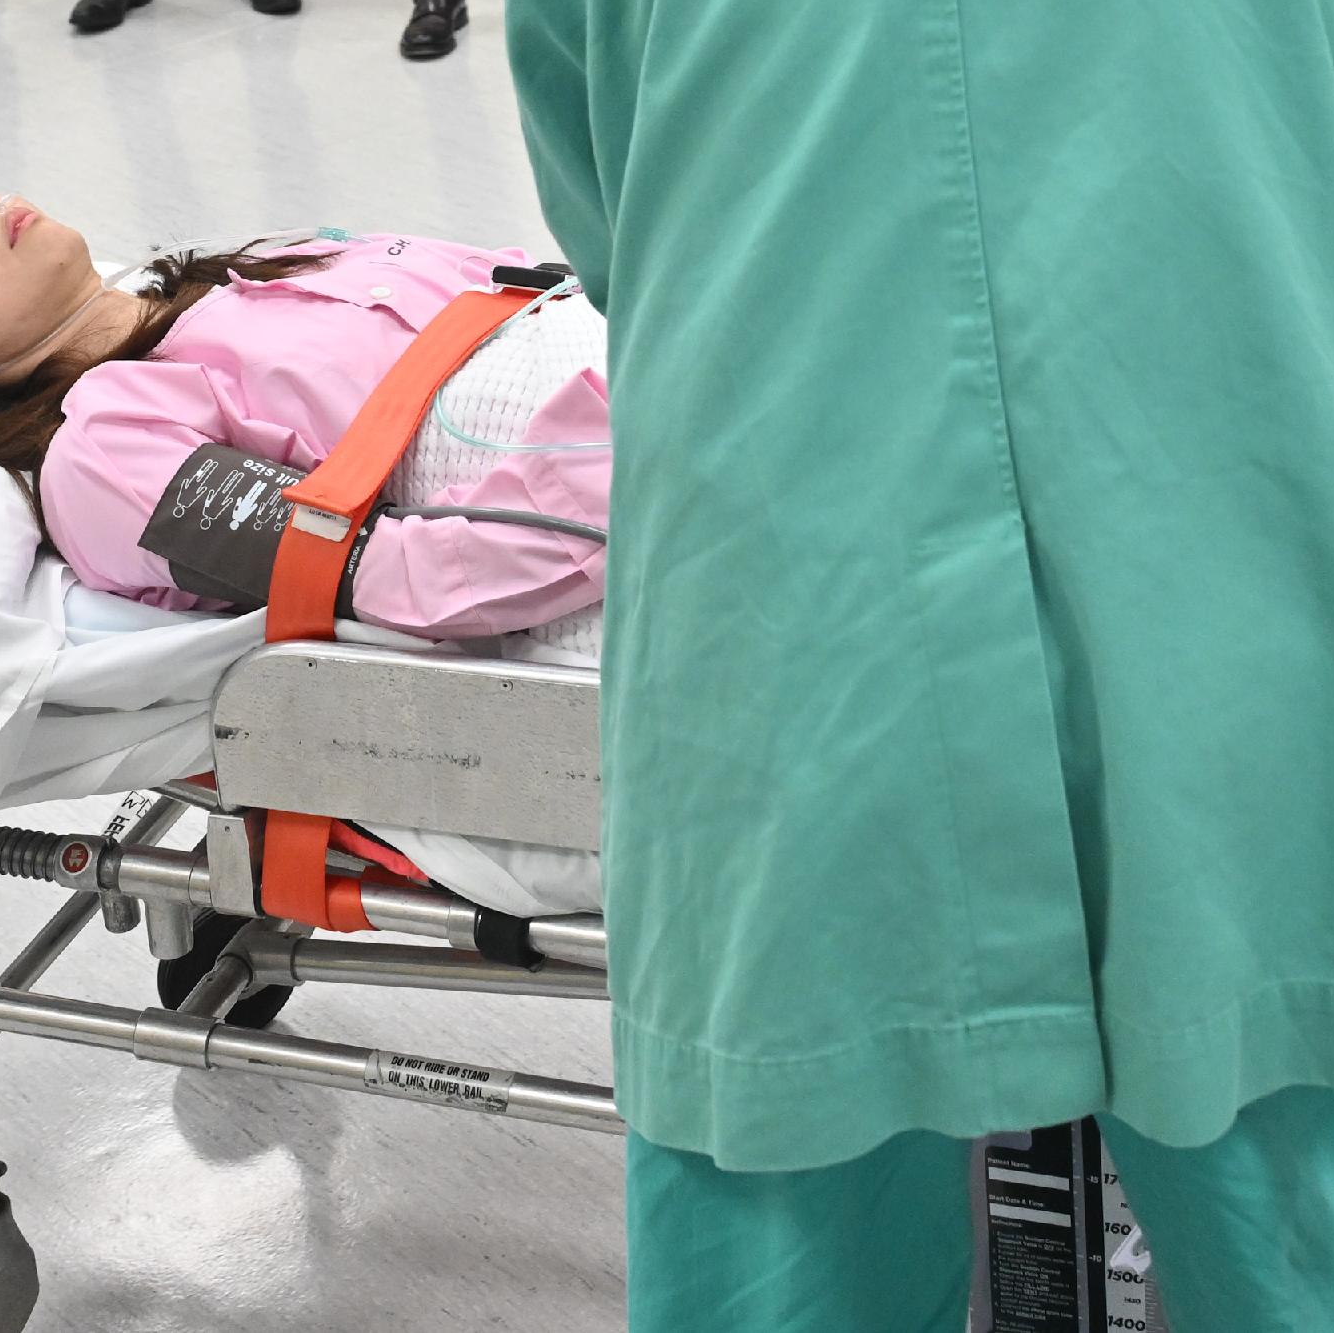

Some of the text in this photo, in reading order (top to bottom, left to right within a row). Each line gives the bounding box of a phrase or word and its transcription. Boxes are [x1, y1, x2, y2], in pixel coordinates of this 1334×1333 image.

[243, 459, 300, 487] ult size
[391, 1056, 490, 1082] DO NOT RIDE OR STAND
[388, 1070, 401, 1083] ON
[406, 1073, 425, 1087] THIS
[429, 1078, 460, 1095] LOWER
[1104, 1222, 1132, 1236] 160
[1107, 1269, 1145, 1284] 1500
[1108, 1315, 1146, 1332] 1400
